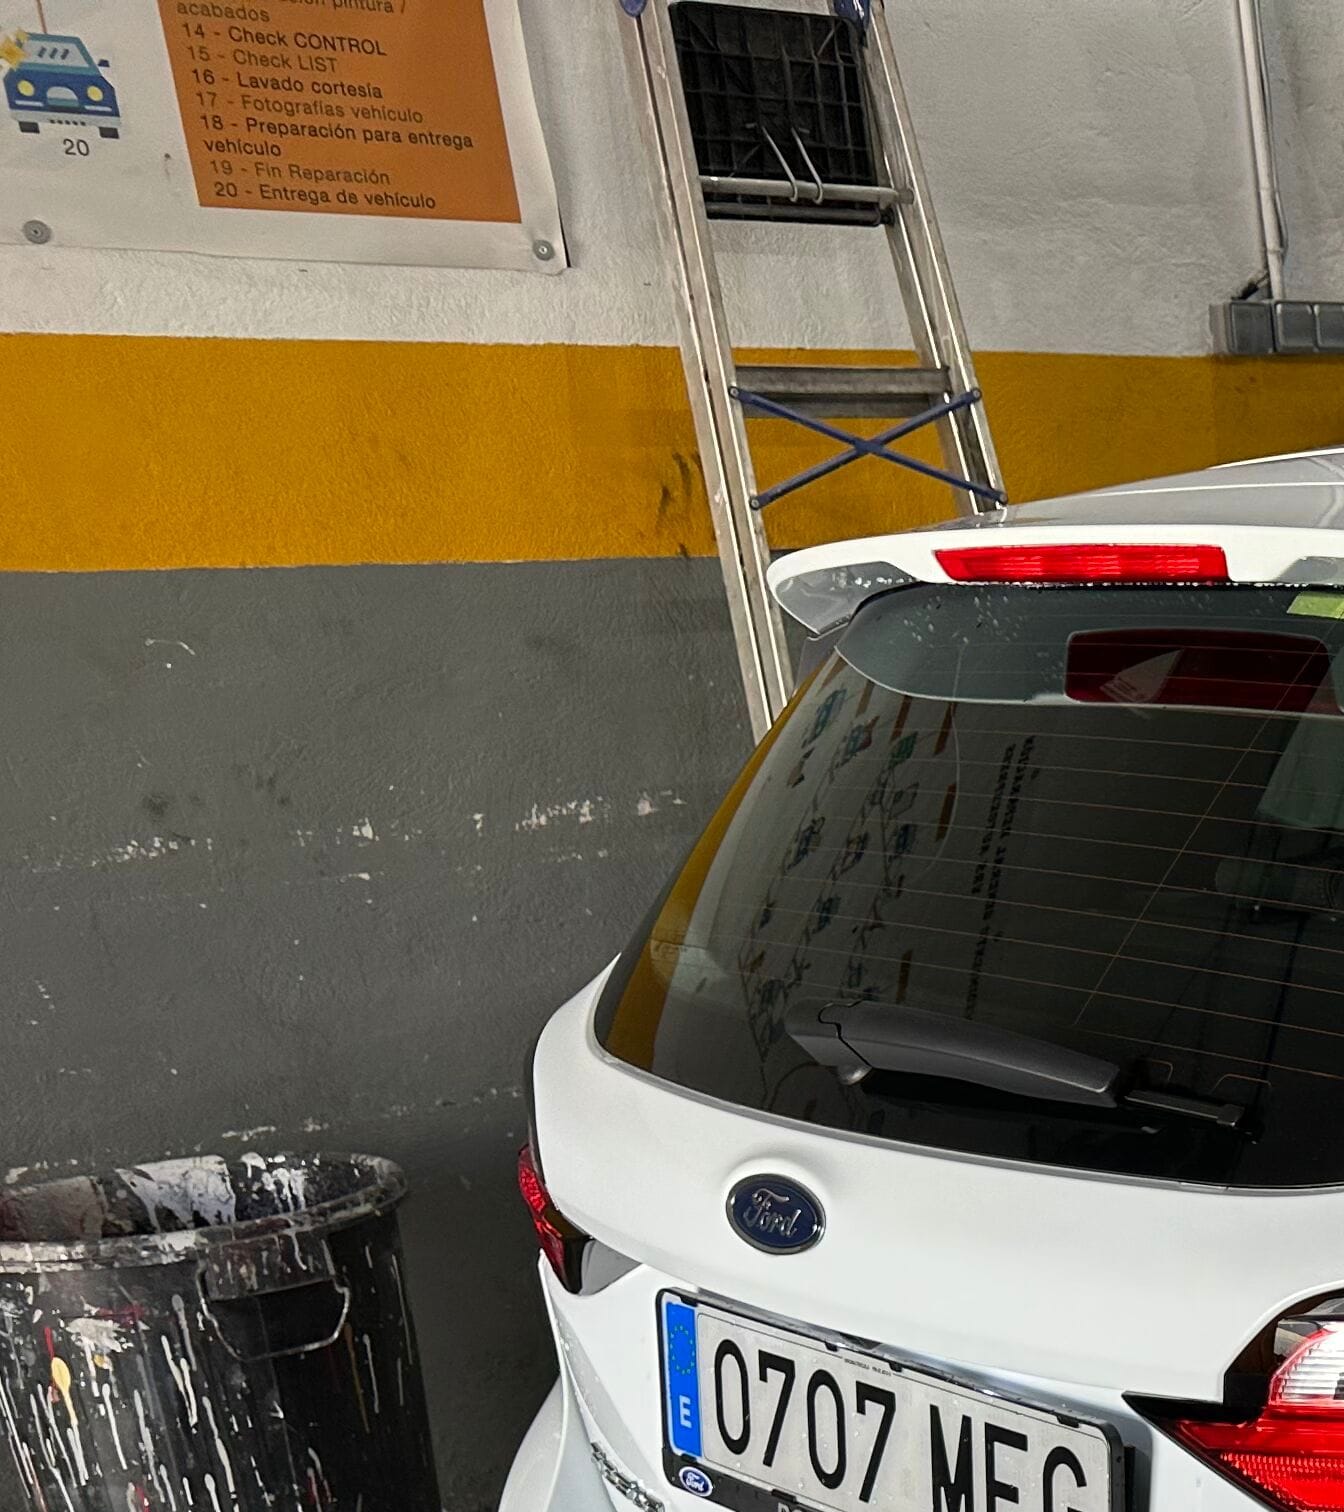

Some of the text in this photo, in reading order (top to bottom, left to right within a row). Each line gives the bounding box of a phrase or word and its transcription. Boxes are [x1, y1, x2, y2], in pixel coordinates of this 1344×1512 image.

[177, 2, 271, 22] acabados
[182, 22, 205, 39] 14
[228, 25, 288, 47] Check
[294, 32, 387, 56] CONTROL
[187, 45, 210, 62] 15
[233, 48, 292, 70] Check
[297, 55, 337, 73] LIST
[191, 68, 215, 85] 16
[237, 71, 304, 92] Lavado
[311, 81, 383, 99] cortesía
[195, 91, 217, 107] 17
[351, 105, 423, 123] vehículo
[63, 138, 90, 157] 20
[200, 114, 224, 130] 18
[245, 117, 356, 140] Preparación
[363, 128, 402, 145] para
[408, 131, 473, 151] entrega
[203, 139, 281, 157] vehículo
[210, 160, 233, 175] 19
[254, 162, 282, 178] Fin
[288, 164, 390, 185] Reparación
[214, 181, 238, 198] 20
[259, 184, 331, 206] Entrega
[336, 189, 359, 205] de
[364, 191, 436, 210] vehículo
[742, 1188, 802, 1239] Ford
[679, 1395, 692, 1429] E
[714, 1339, 897, 1503] 0707
[686, 1472, 705, 1492] Ford
